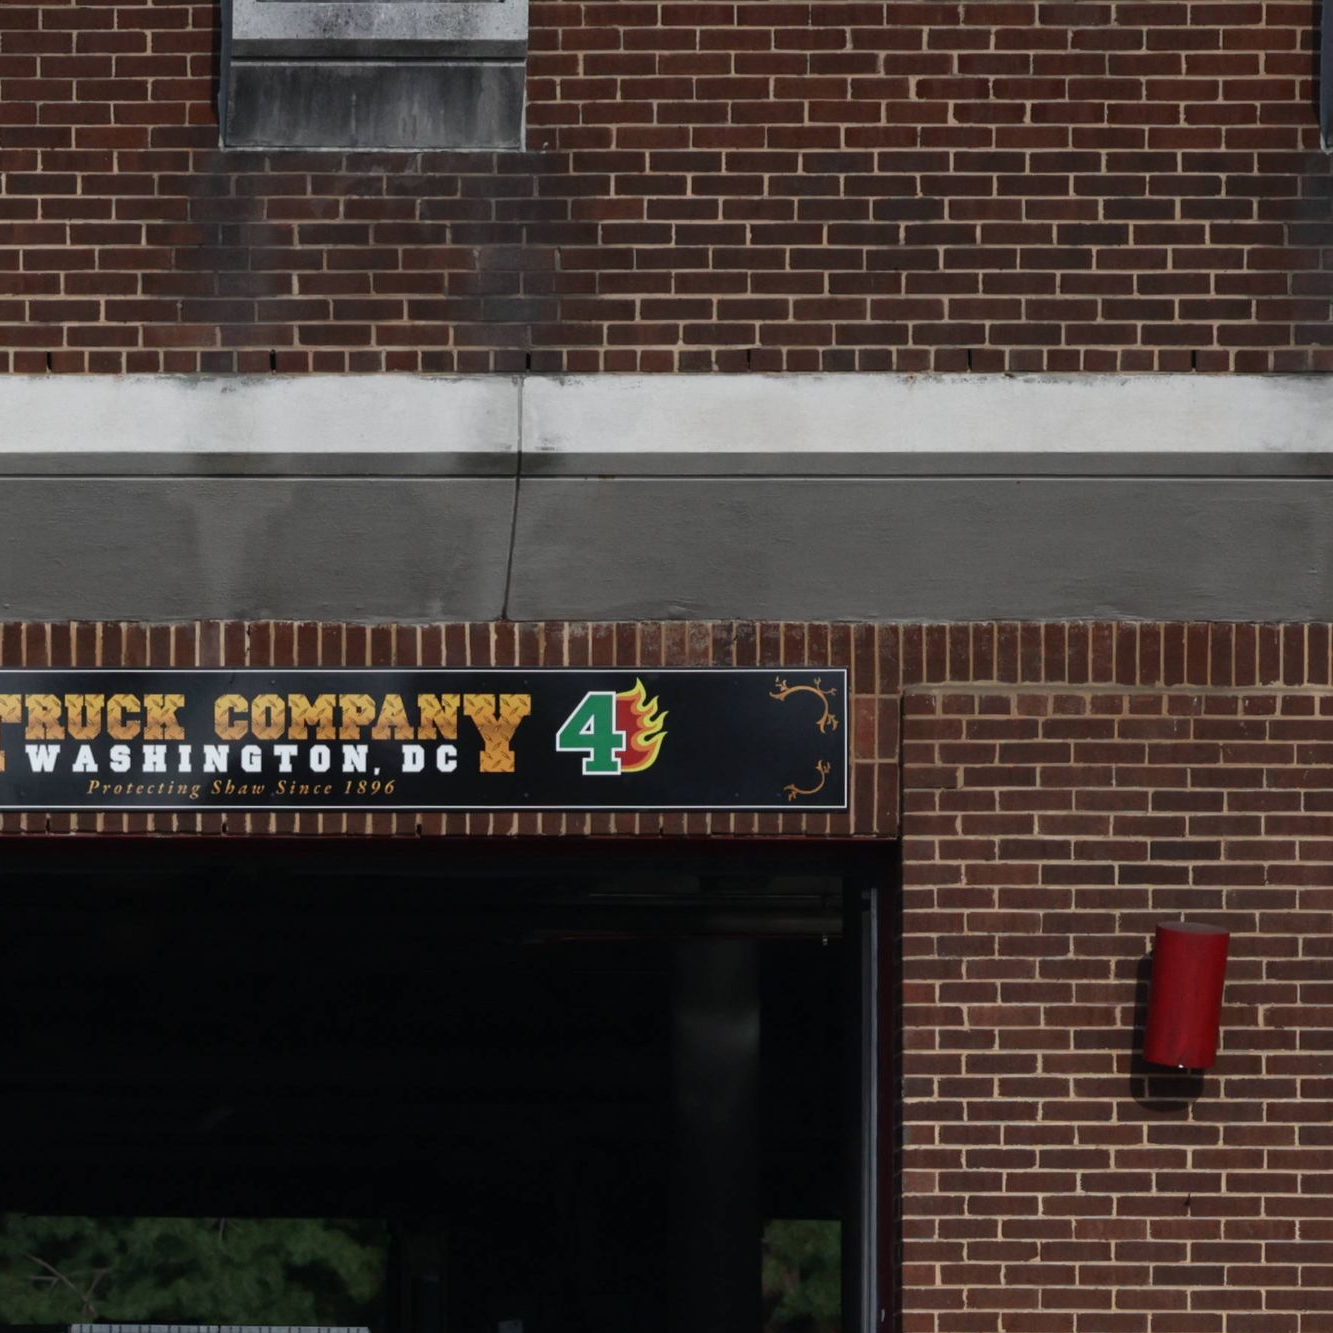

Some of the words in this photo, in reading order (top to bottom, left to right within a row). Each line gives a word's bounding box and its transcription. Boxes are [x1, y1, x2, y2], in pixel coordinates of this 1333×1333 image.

[214, 693, 532, 773] COMPANY
[555, 690, 627, 776] 4
[25, 743, 381, 777] WASHINGTON,
[401, 743, 459, 773] DC
[86, 778, 200, 799] Protecting
[210, 778, 265, 795] Shaw
[276, 779, 335, 795] Since
[343, 779, 397, 796] 1896
